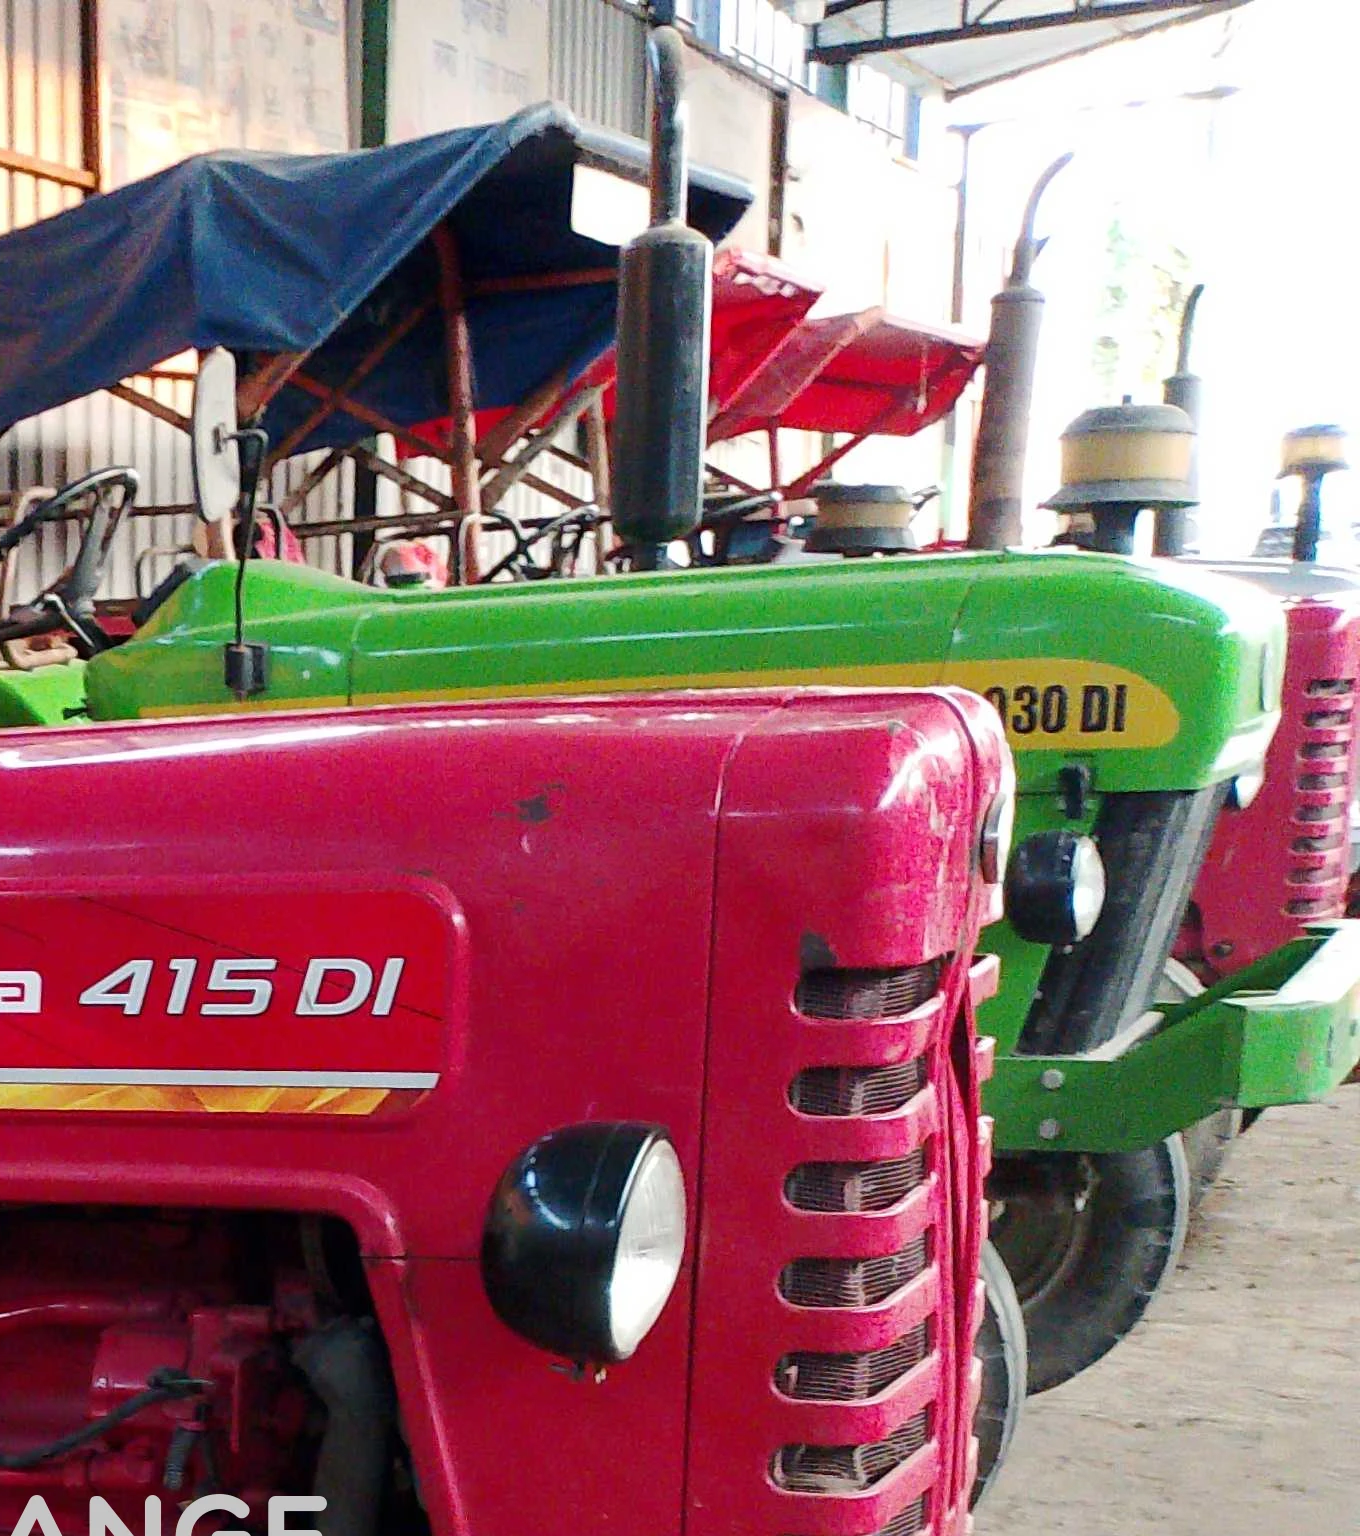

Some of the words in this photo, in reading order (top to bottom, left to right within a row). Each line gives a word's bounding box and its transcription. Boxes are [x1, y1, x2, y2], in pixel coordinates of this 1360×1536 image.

[1080, 684, 1127, 732] DI
[78, 958, 272, 1017] 415
[294, 956, 404, 1019] DI
